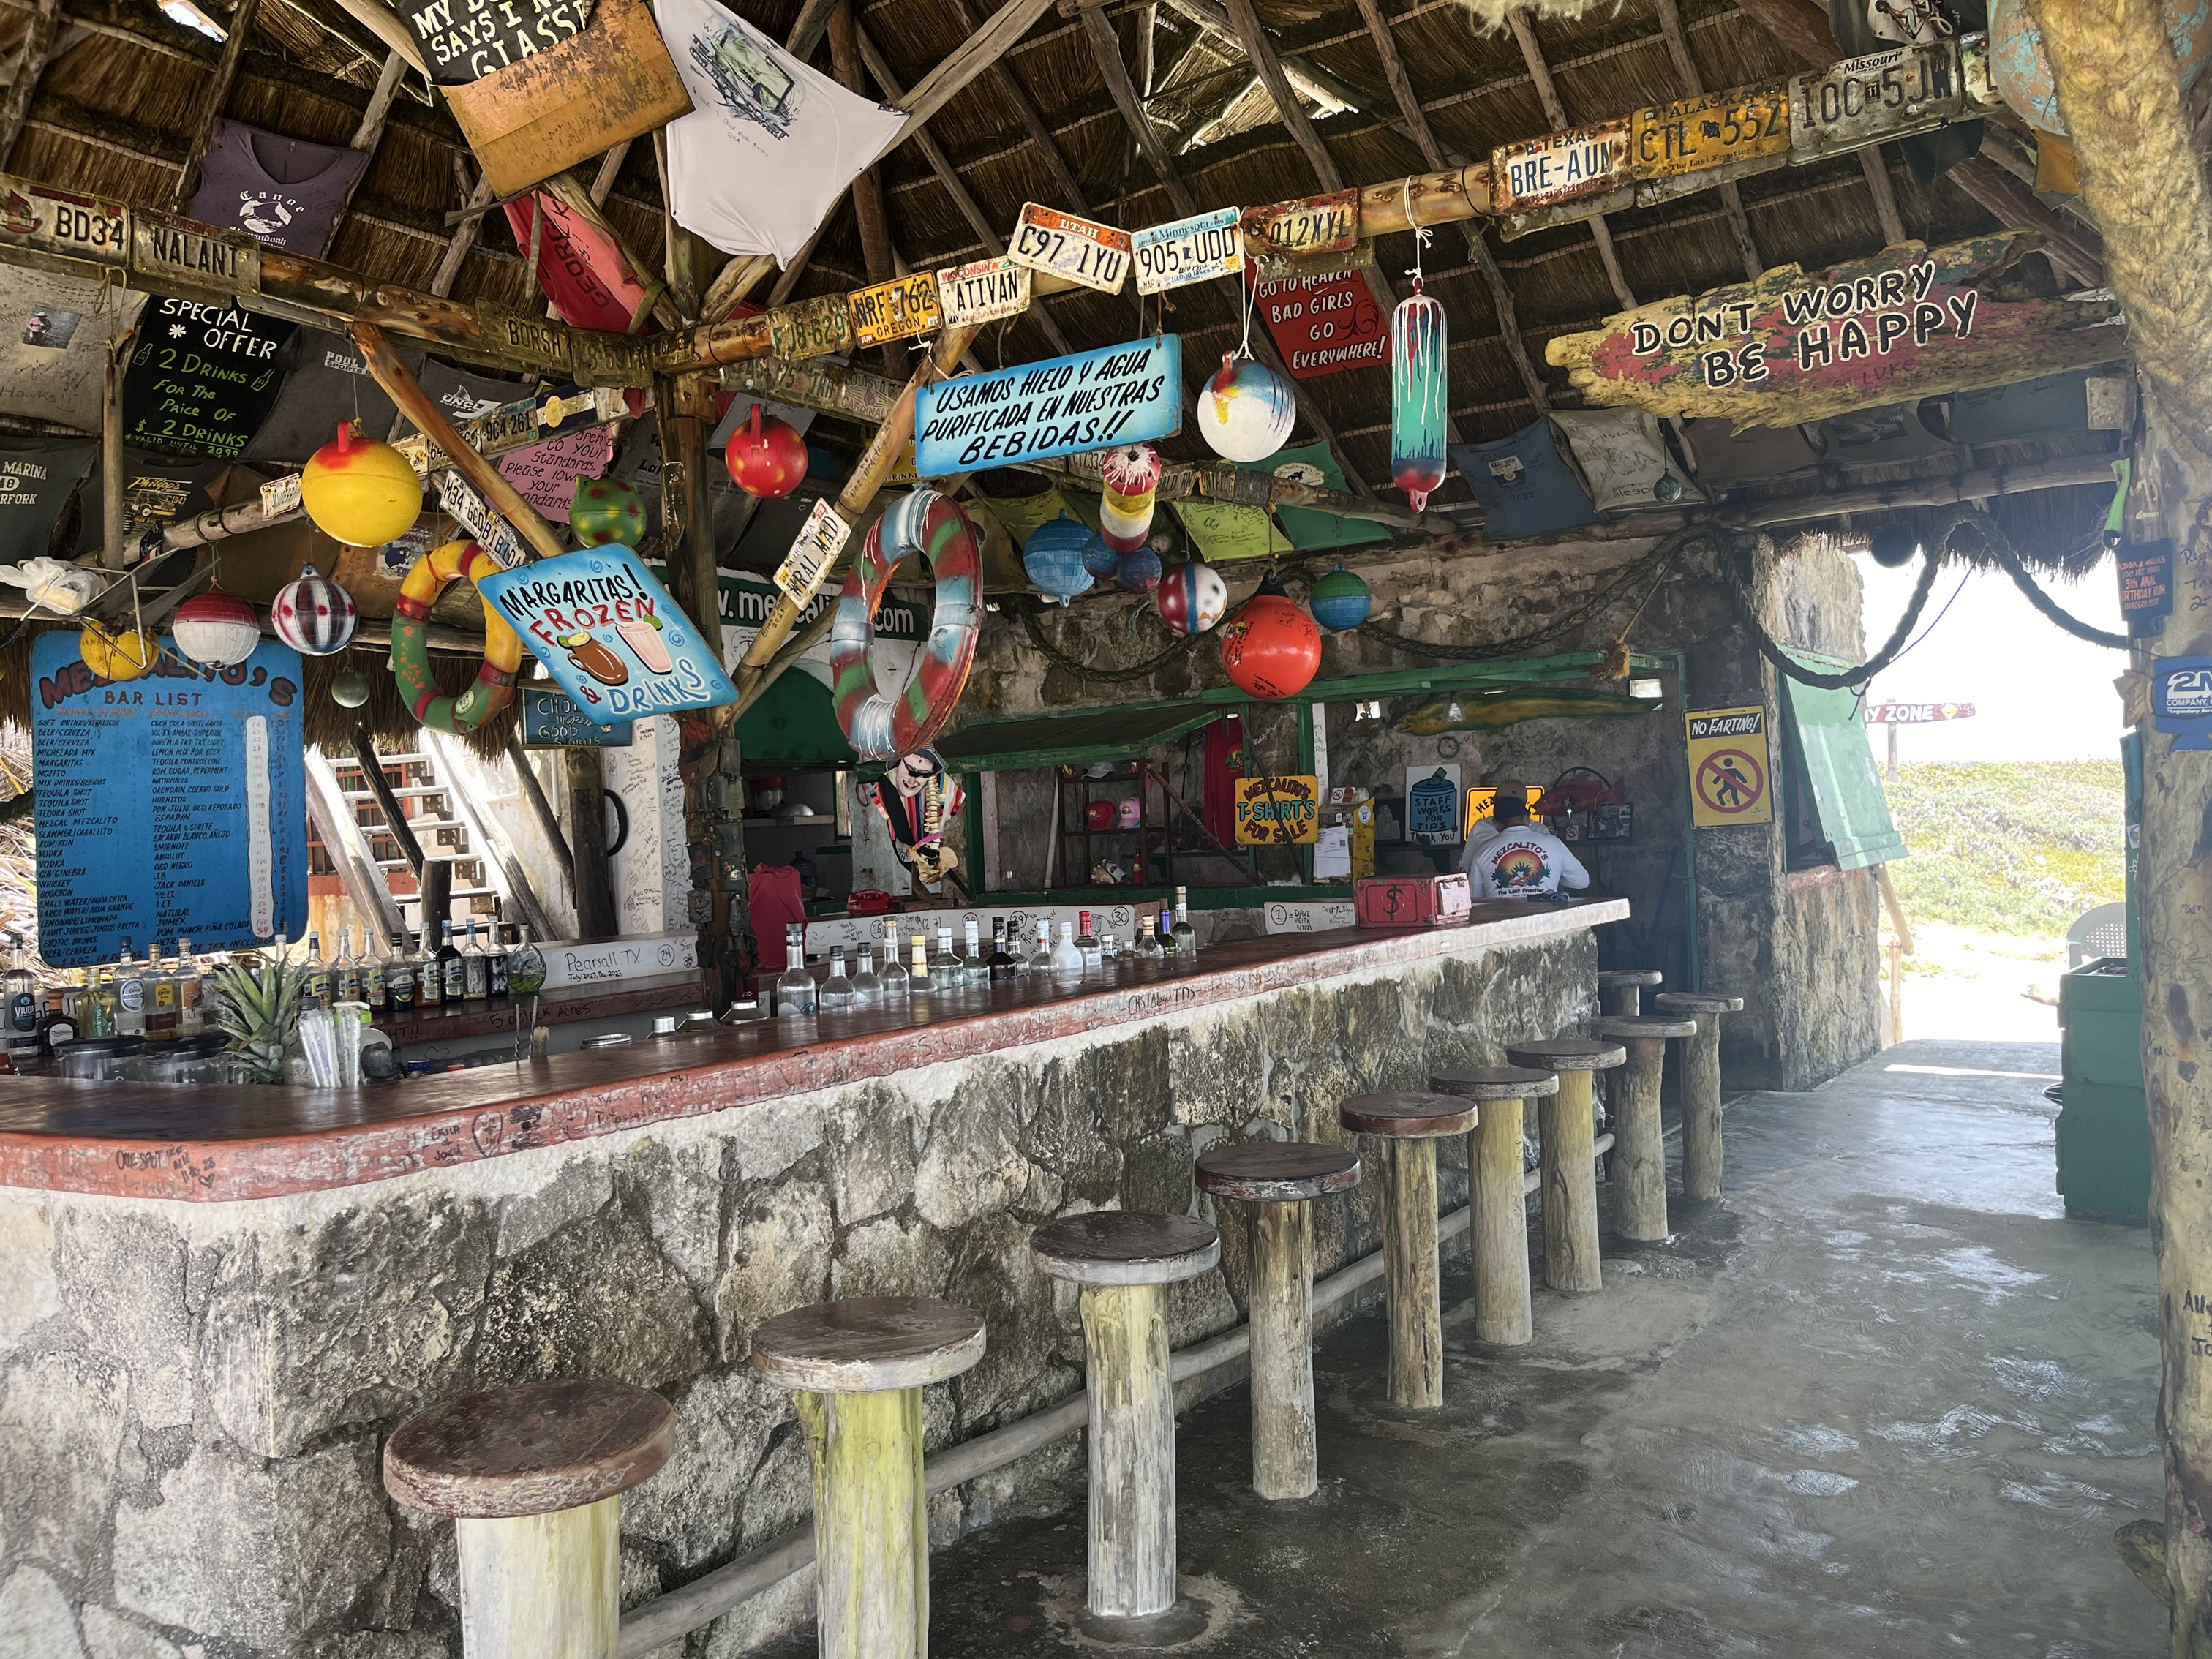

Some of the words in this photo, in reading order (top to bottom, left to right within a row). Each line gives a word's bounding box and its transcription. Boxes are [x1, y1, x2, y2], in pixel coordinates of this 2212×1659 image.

[412, 2, 454, 40] MY
[432, 10, 495, 66] SAYS
[1844, 53, 1900, 74] Missouri
[1541, 127, 1596, 151] TEXAS
[1639, 119, 1696, 162] CTL
[1688, 155, 1710, 168] Last
[1058, 218, 1099, 241] UTAH
[1139, 241, 1180, 277] 905
[1194, 226, 1237, 264] UDD
[941, 263, 990, 282] WISCONSIN
[957, 269, 1017, 312] ATIVAN
[1259, 282, 1277, 298] GO
[854, 290, 886, 328] NRF
[895, 279, 934, 317] 762
[1271, 301, 1303, 323] BAD
[1309, 291, 1353, 315] GIRLS
[1632, 303, 1755, 357] DON'T
[1783, 260, 1936, 325] WORRY
[877, 317, 920, 338] OREGON
[1309, 321, 1335, 342] GO
[204, 328, 277, 359] OFFER
[859, 333, 874, 345] JUN
[1702, 343, 1769, 389] BE
[1797, 290, 1977, 371] HAPPY
[159, 349, 176, 369] 2
[1292, 335, 1387, 370] EVERYWHERE!
[936, 377, 1015, 414] USAMOS
[1019, 365, 1073, 396] HIELO
[1080, 361, 1094, 385] Y
[1097, 348, 1151, 381] AGUA
[921, 401, 1033, 443] PURIFICADA
[1037, 394, 1060, 423] EN
[1061, 375, 1165, 418] NUESTRAS
[958, 410, 1134, 465] BEBIDAS!!
[207, 445, 239, 458] 2099
[3, 461, 47, 480] MARINA
[500, 564, 647, 621] MARGARITAS!
[529, 598, 654, 647] FROZEN
[607, 658, 710, 715] DRINKS
[105, 691, 143, 705] BAR
[156, 692, 203, 706] LIST
[1885, 705, 1933, 721] ZONE
[539, 726, 579, 737] GOOD
[1691, 721, 1707, 735] NO
[1709, 713, 1761, 735] FARTING!
[80, 748, 97, 757] MIX
[37, 759, 84, 767] MARGARITAS
[37, 779, 52, 787] MIX
[37, 789, 69, 797] TEQUILA
[72, 788, 93, 797] SHOT
[151, 795, 187, 804] HORNITOS
[1415, 795, 1451, 807] STAFF
[67, 808, 87, 817] SHOT
[1416, 804, 1452, 816] WORKS
[1425, 813, 1443, 823] FOR
[1244, 819, 1270, 841] FOR
[1416, 821, 1448, 831] TIPS
[38, 849, 64, 859] VODKA
[1491, 841, 1549, 865] MEZCALITO'S
[38, 859, 65, 869] VODKA
[38, 879, 72, 889] WHISKEY
[153, 880, 176, 890] JACK
[1113, 911, 1129, 922] 30
[1294, 908, 1311, 917] DAVE
[660, 949, 672, 961] 24
